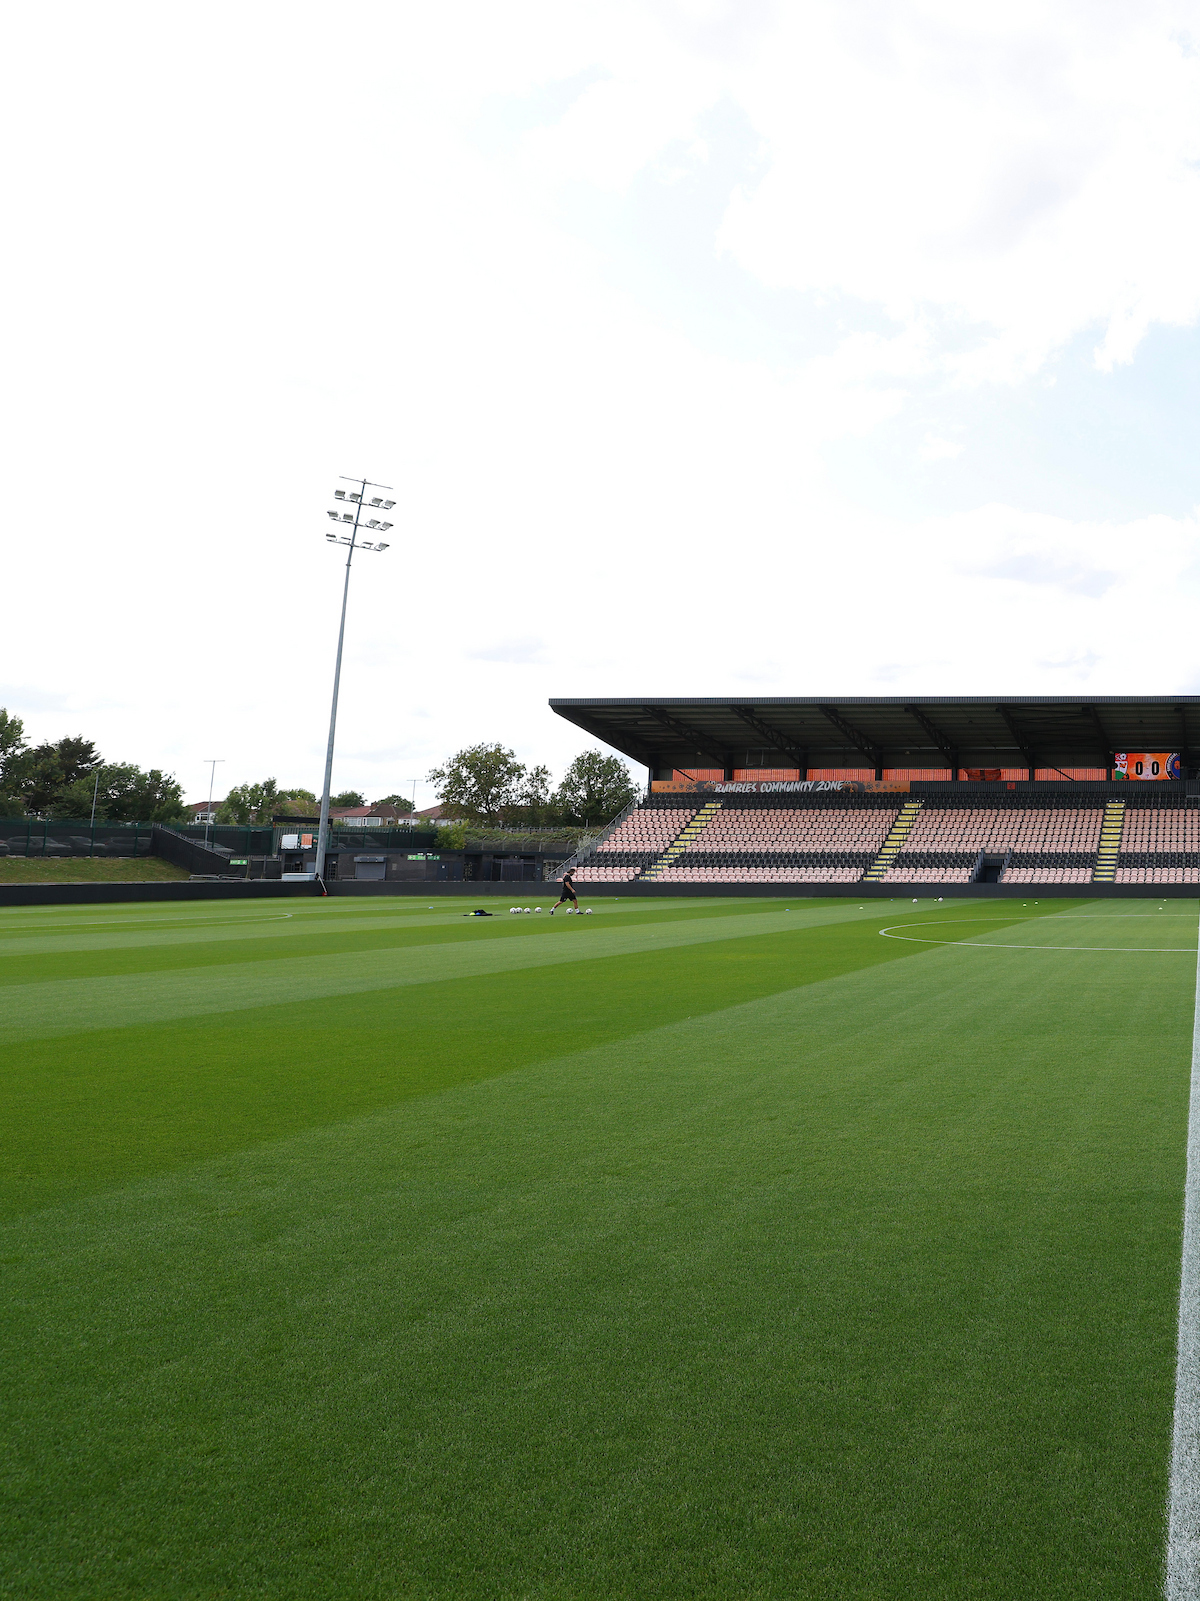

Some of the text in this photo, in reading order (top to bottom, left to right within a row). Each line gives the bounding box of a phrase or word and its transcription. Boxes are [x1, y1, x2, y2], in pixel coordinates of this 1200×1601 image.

[1136, 761, 1143, 775] 0
[1152, 761, 1159, 775] 0
[760, 781, 815, 792] COMMUNITY
[816, 781, 844, 792] ZONE
